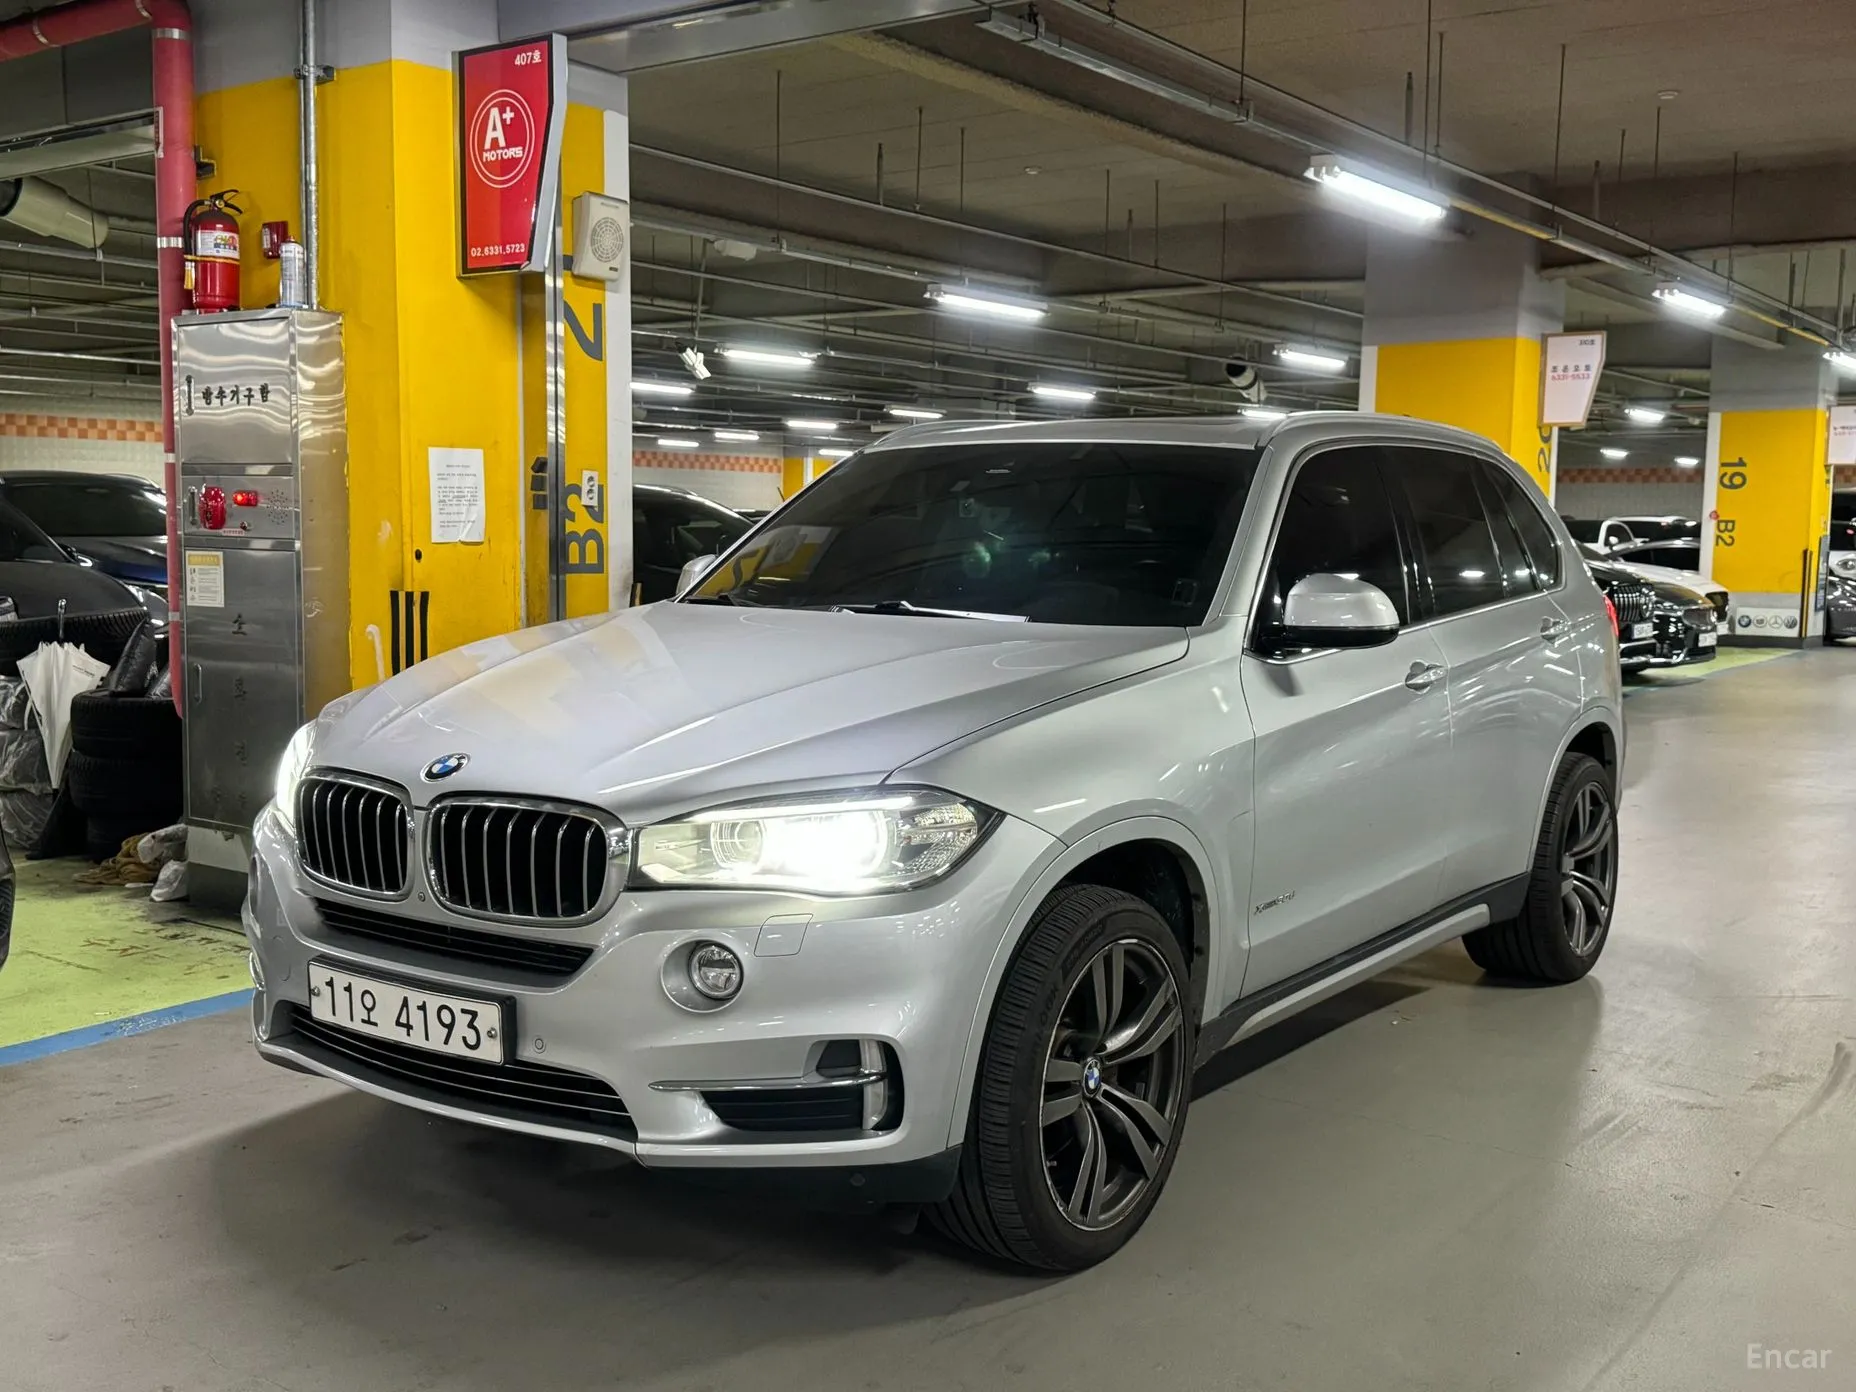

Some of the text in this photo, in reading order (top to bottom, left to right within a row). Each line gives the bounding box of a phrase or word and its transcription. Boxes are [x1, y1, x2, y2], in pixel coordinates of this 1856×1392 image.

[514, 50, 542, 66] 407호
[484, 106, 515, 149] A+
[483, 146, 523, 162] MOTORS
[471, 243, 526, 257] 02.6331.5723
[1719, 456, 1748, 490] 19
[564, 483, 604, 575] B2
[1715, 519, 1736, 547] B2
[325, 976, 481, 1050] 11오 4193
